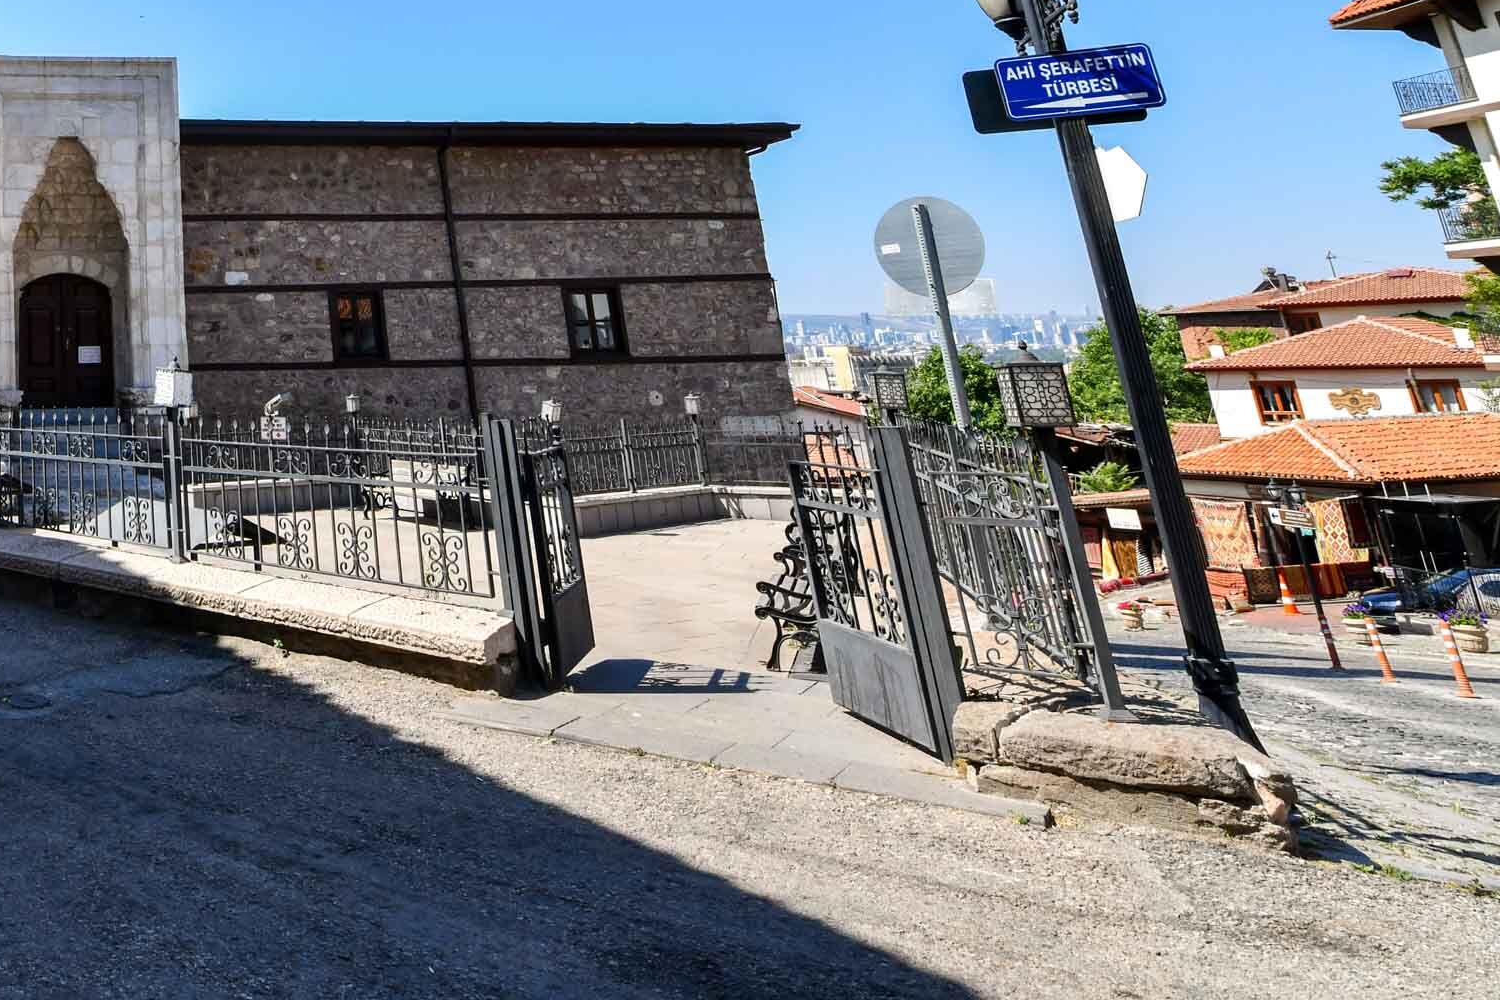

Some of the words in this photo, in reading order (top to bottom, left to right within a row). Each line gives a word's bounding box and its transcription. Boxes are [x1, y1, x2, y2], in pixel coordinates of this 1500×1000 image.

[1006, 62, 1036, 81] AHİ
[1039, 50, 1146, 80] ŞERAFETTİN
[1042, 73, 1119, 98] TÜRBESİ
